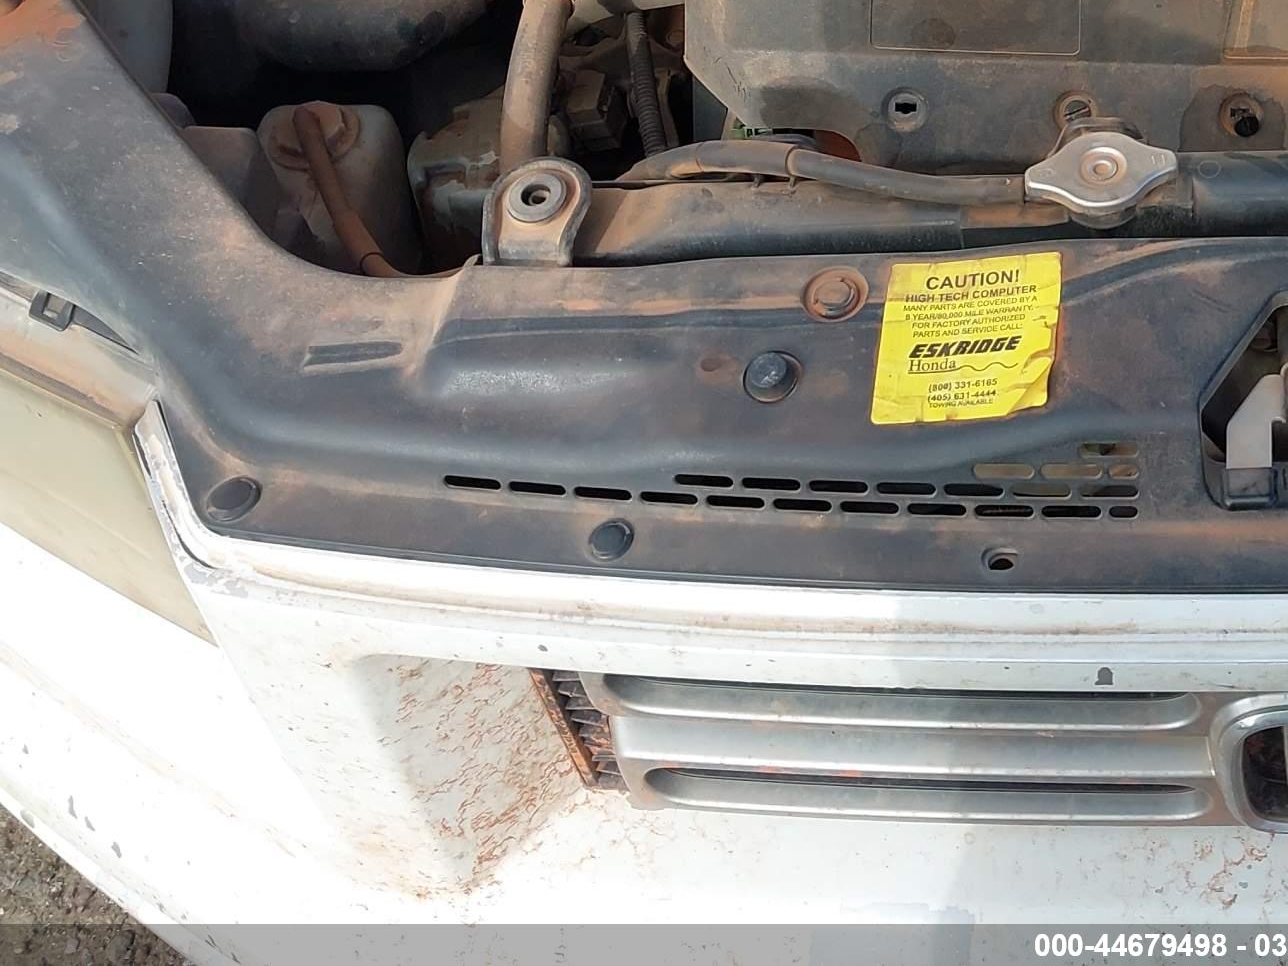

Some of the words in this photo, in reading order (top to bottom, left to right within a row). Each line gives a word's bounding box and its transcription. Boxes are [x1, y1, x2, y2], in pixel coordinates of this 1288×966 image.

[926, 269, 1020, 290] CAUTION!
[905, 291, 969, 303] HIGH-TECH
[972, 284, 1037, 299] COMPUTER
[903, 303, 928, 312] MANY
[929, 303, 957, 311] PARTS
[958, 301, 975, 309] ARE
[977, 297, 1018, 307] COVERED
[912, 321, 930, 329] FOR
[932, 319, 971, 328] FACTORY
[972, 314, 1026, 325] AUTHORIZED
[912, 330, 940, 338] PARTS
[961, 325, 998, 335] SERVICE
[999, 322, 1023, 331] CALL:
[908, 335, 1022, 358] ESKRIDGE
[908, 358, 956, 372] Honda
[928, 382, 952, 393] (800)
[927, 393, 951, 403] (405)
[954, 389, 996, 400] 631-4444
[929, 400, 957, 409] TOWING
[958, 398, 994, 406] AVAILABLE
